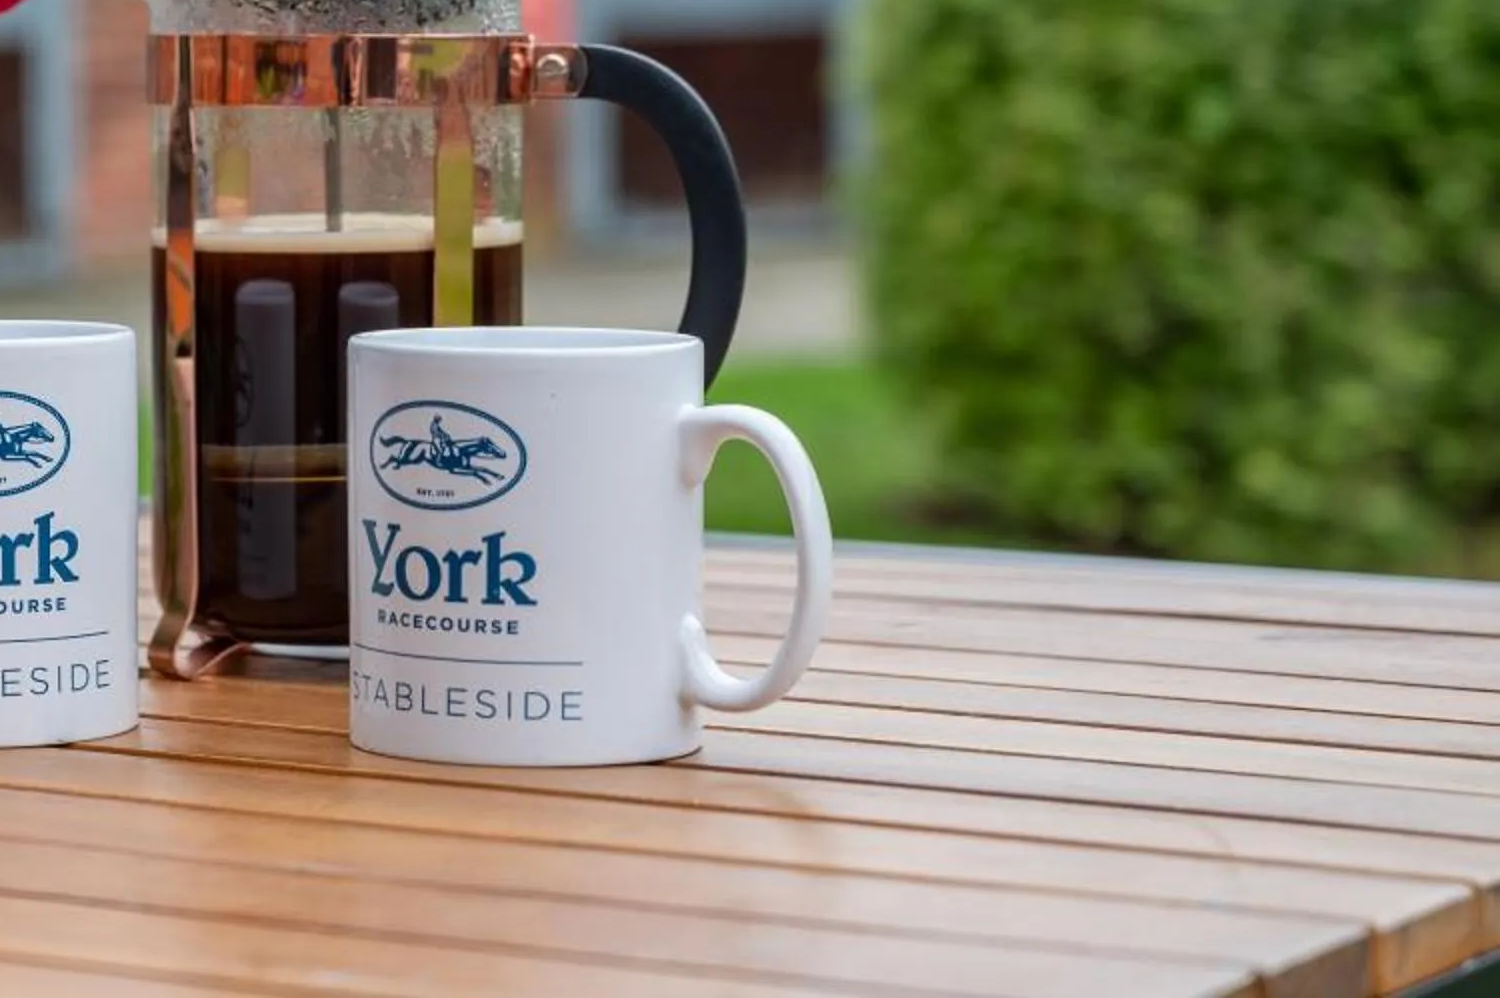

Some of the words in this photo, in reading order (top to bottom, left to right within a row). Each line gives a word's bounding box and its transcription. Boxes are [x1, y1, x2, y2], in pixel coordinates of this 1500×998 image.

[361, 519, 538, 606] York
[377, 608, 520, 636] RACECOURSE
[353, 670, 583, 722] STABLESIDE
